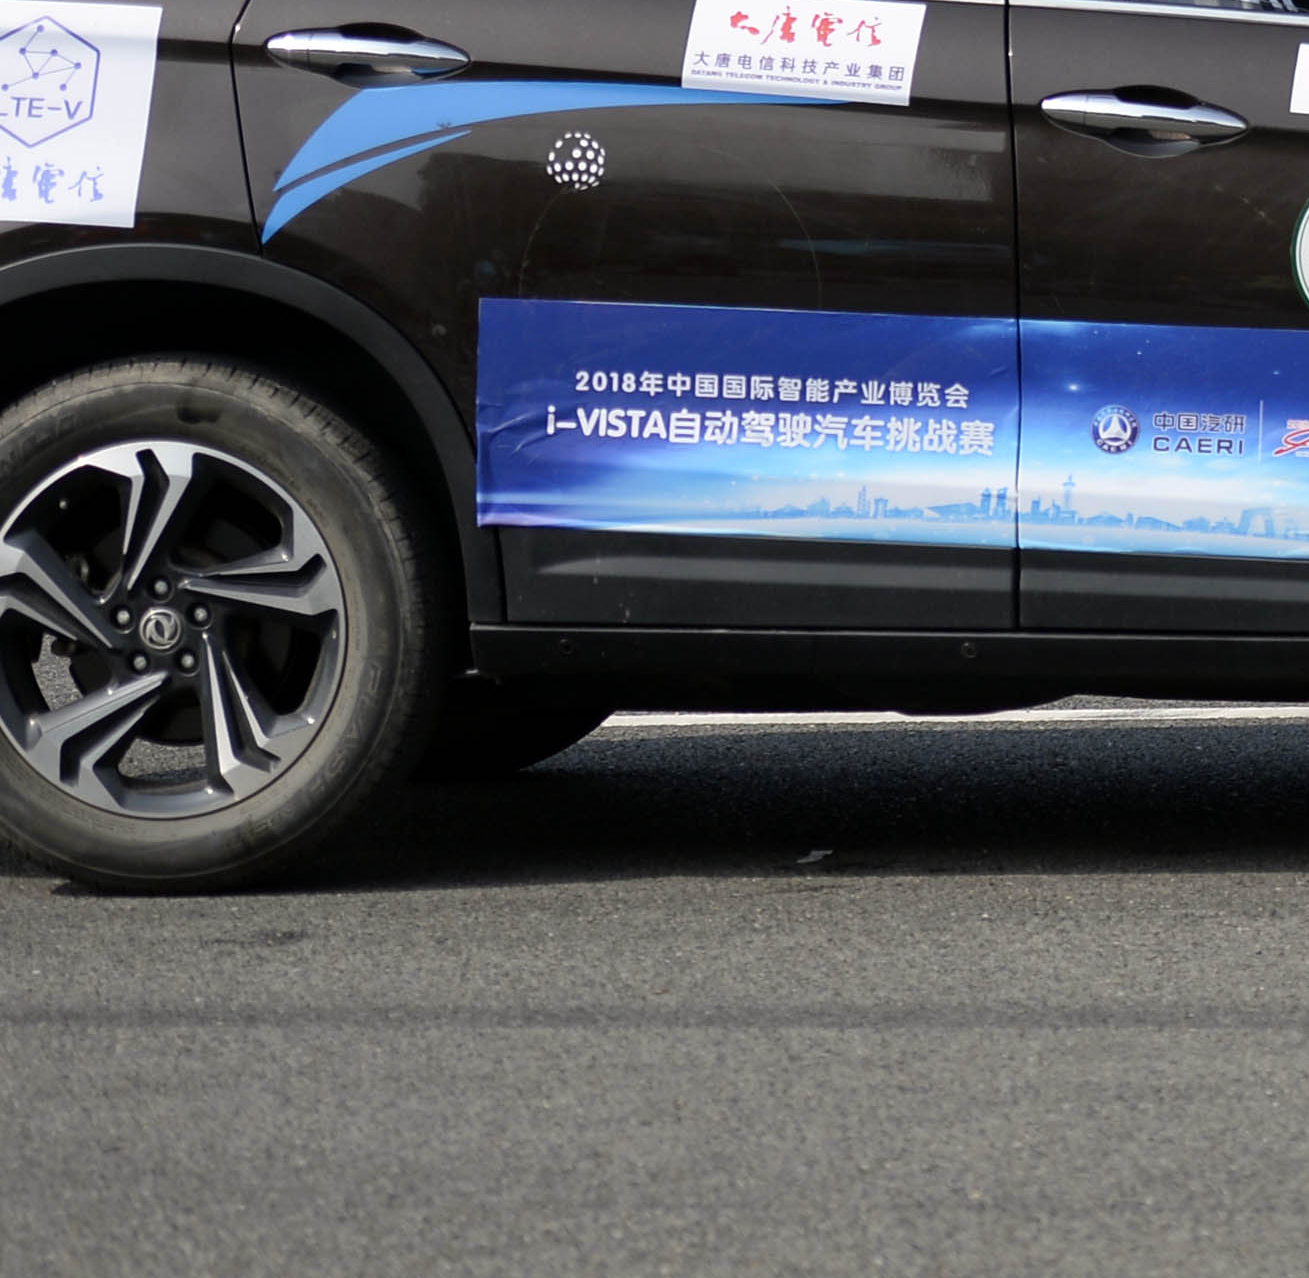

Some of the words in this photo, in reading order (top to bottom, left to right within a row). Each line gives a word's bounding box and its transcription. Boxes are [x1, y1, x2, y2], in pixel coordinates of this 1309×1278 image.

[693, 51, 905, 81] 大唐电信科技产业集团
[690, 69, 722, 78] DATANG
[724, 71, 763, 80] TELECOM
[765, 73, 820, 85] TECHNOLOGY
[831, 79, 872, 89] INDUSTRY
[874, 83, 903, 91] GROUP
[574, 370, 970, 409] 2018年中国国际智能产业博览会
[545, 405, 996, 457] i-VISTA自动驾驶汽车挑战赛
[1153, 410, 1246, 434] 中国汽研
[1153, 435, 1244, 456] CAERI
